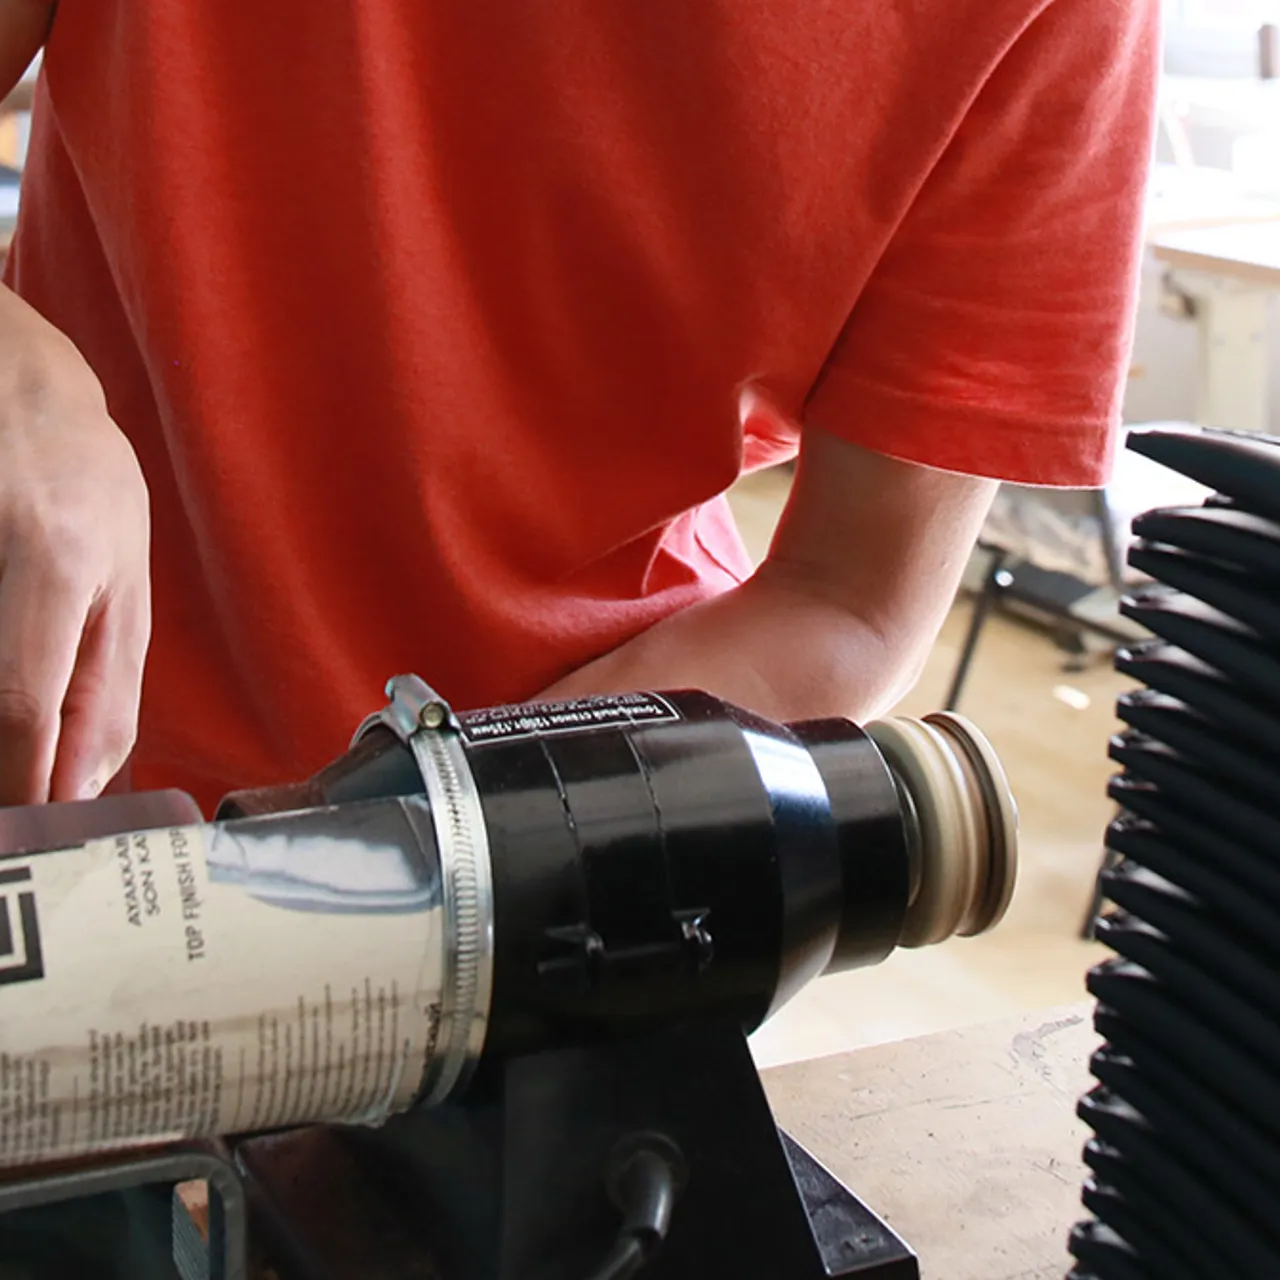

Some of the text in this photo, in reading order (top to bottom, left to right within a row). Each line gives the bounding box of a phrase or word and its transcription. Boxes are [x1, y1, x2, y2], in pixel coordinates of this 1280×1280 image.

[139, 869, 161, 916] SON
[176, 862, 205, 920] FINISH
[184, 925, 206, 961] TOP
